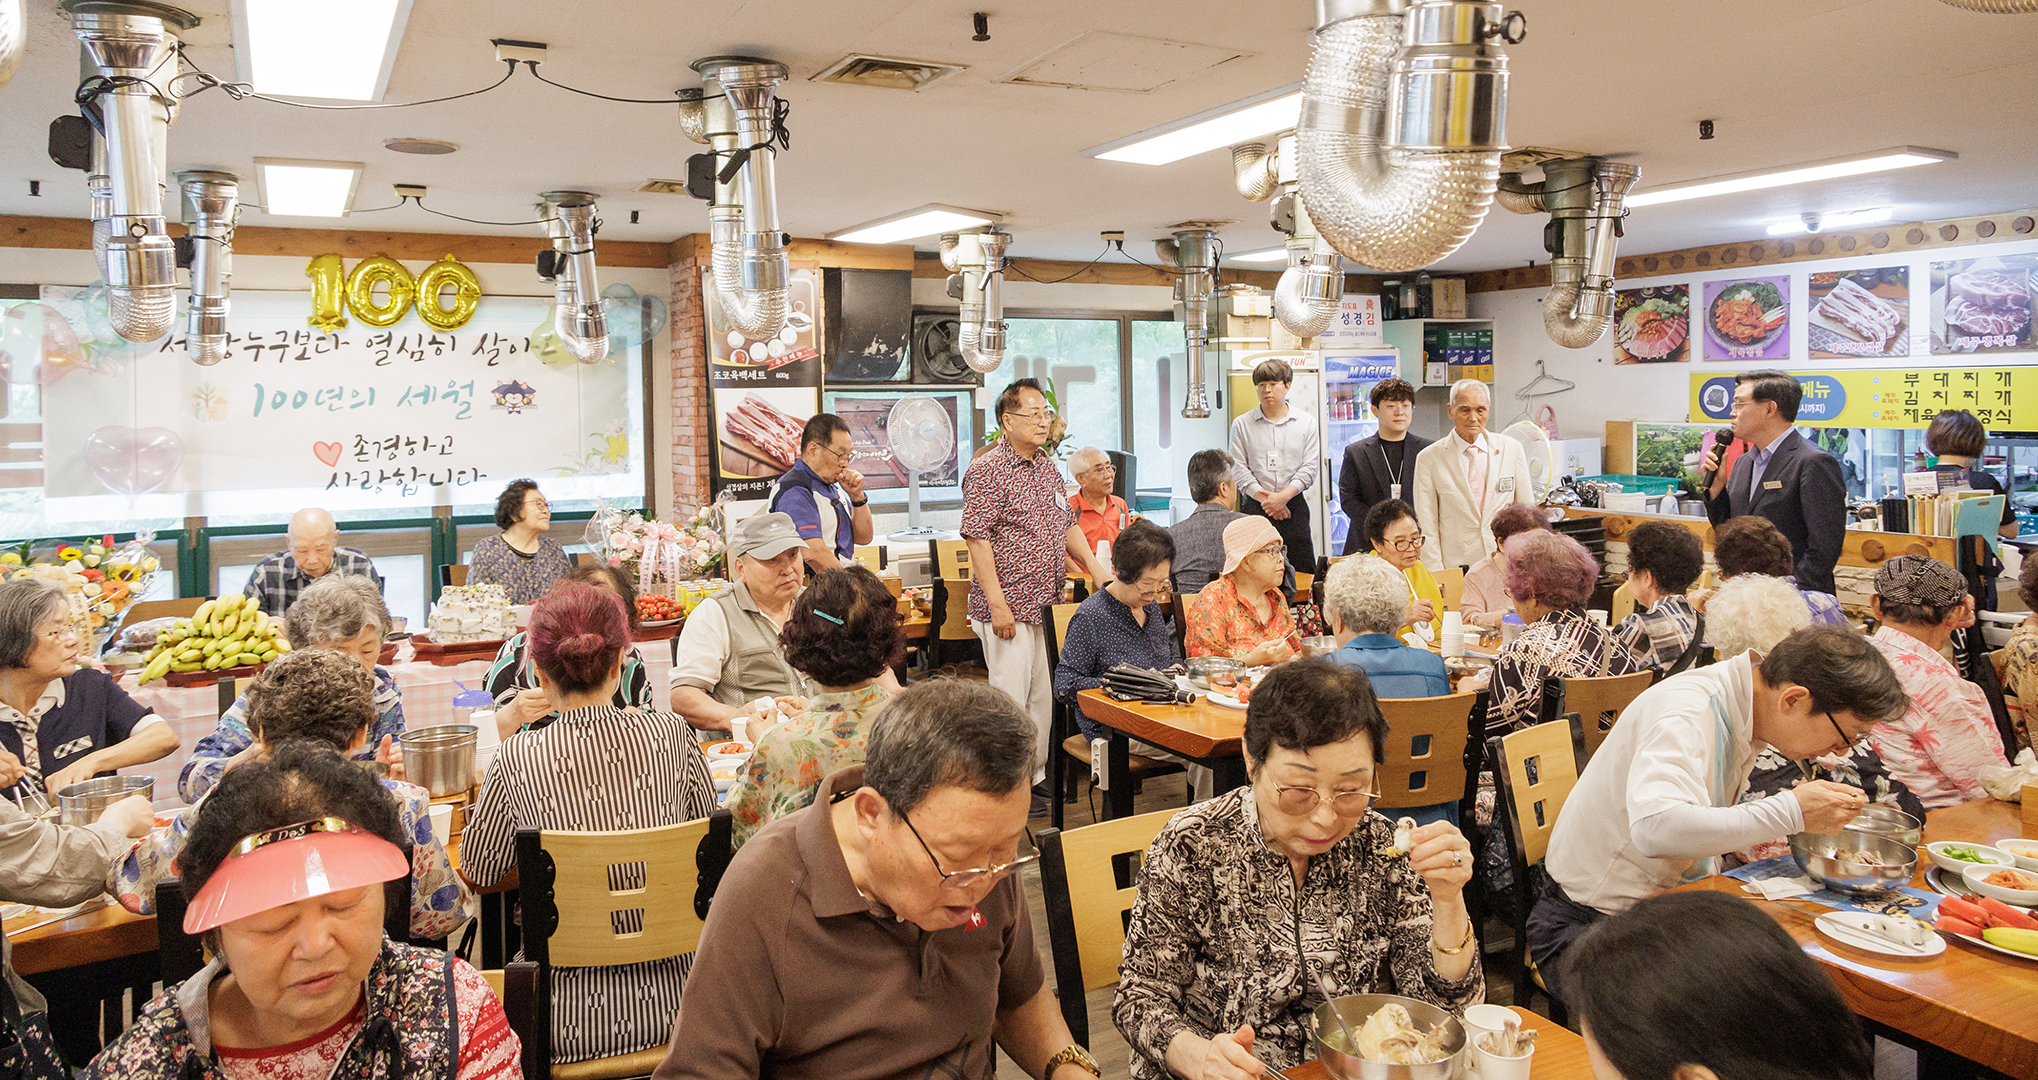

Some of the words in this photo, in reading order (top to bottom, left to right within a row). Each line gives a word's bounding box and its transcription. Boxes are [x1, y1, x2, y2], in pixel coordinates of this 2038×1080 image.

[306, 252, 482, 335] 100
[1341, 302, 1357, 310] 지도표
[366, 331, 456, 366] 열심히
[1829, 341, 1884, 353] 제주생오겹살
[1959, 335, 2018, 348] 제주생목살
[1289, 358, 1306, 366] FUN
[775, 372, 790, 380] 600g
[253, 382, 376, 417] 100년의
[396, 379, 475, 420] 세월
[1903, 408, 2012, 425] 제육정식
[353, 433, 454, 462] 존경하고
[325, 466, 488, 497] 사랑합니다
